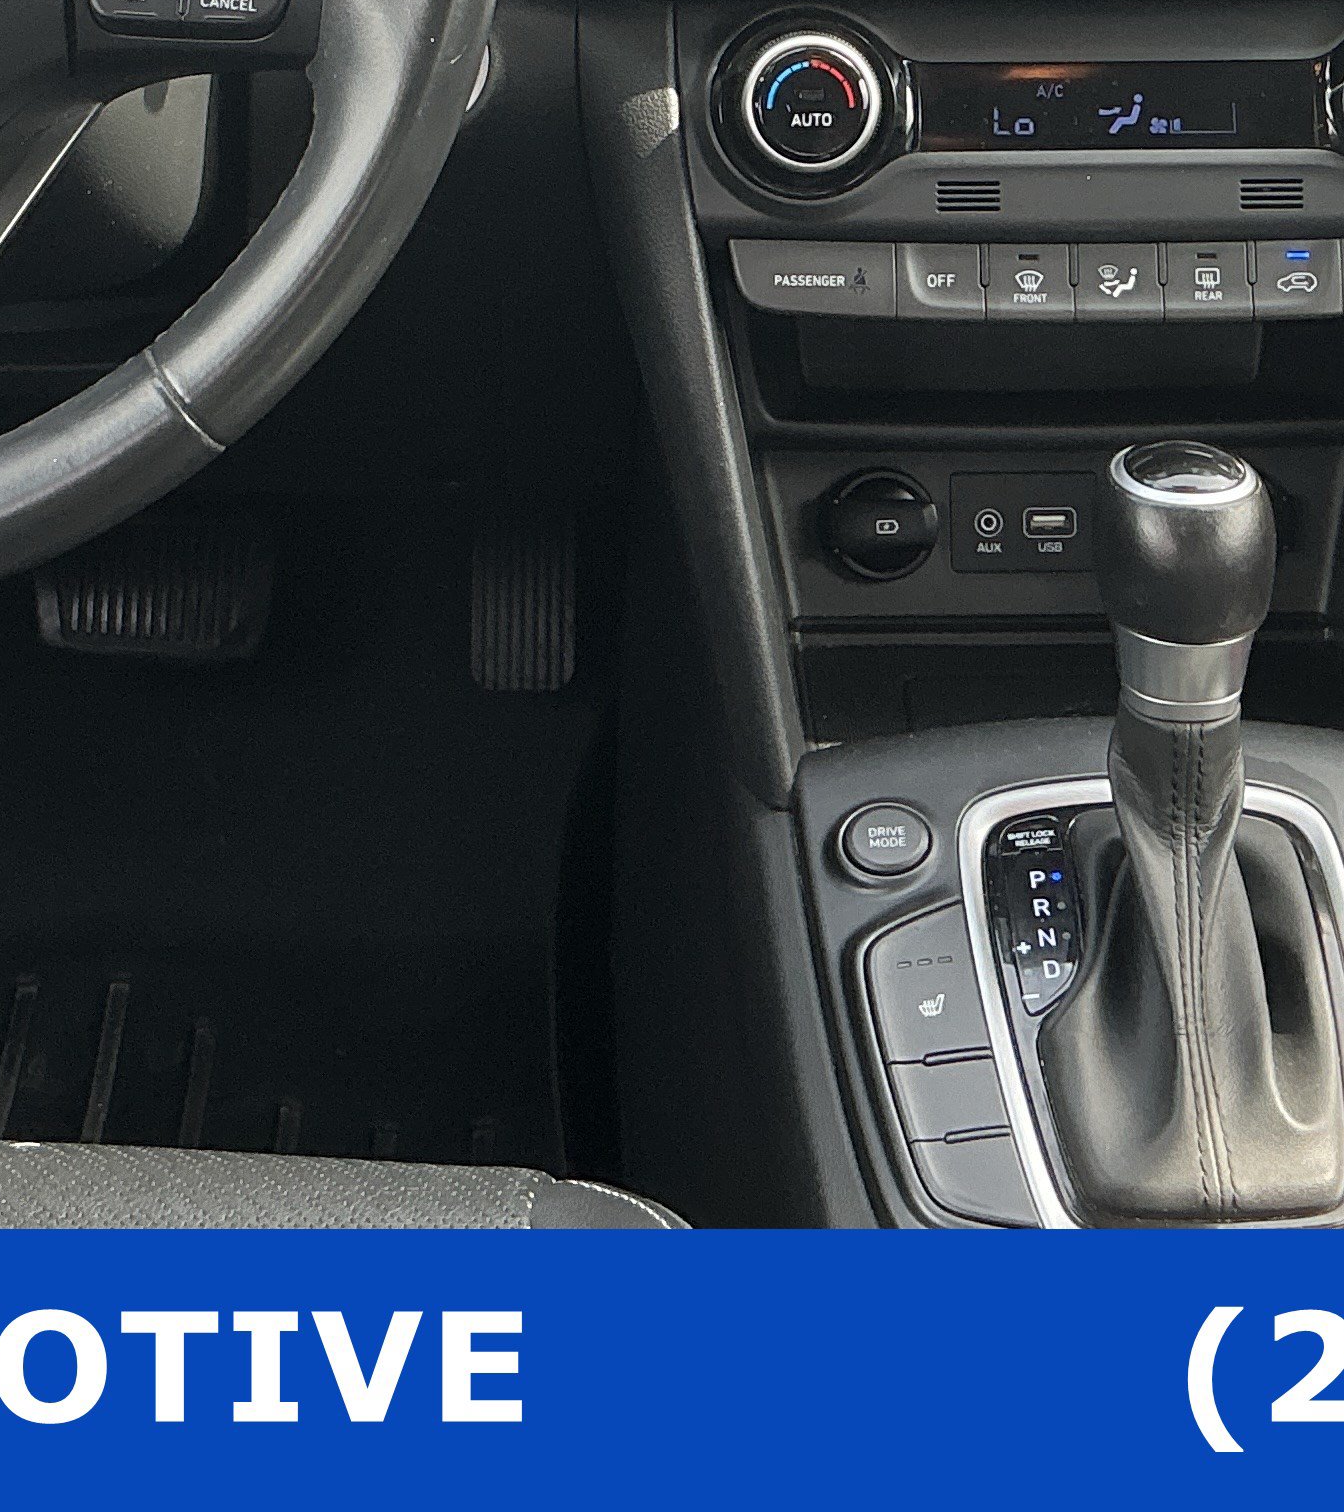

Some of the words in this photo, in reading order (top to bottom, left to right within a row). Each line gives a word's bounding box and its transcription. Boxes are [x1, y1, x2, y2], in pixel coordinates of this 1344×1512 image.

[1036, 84, 1064, 99] A/C
[791, 113, 833, 127] AUTO
[993, 106, 1035, 136] Lo
[774, 274, 846, 288] PASSENGER
[926, 274, 956, 288] OFF
[1013, 292, 1048, 304] FRONT
[1195, 289, 1223, 301] REAR
[977, 541, 1002, 554] AUX
[1037, 541, 1063, 554] USB
[867, 824, 906, 837] DRIVE
[1031, 829, 1056, 839] LOCK
[868, 835, 907, 848] MODE
[1029, 870, 1046, 889] P
[1033, 898, 1051, 917] R
[1038, 927, 1057, 947] N
[1043, 959, 1062, 979] D
